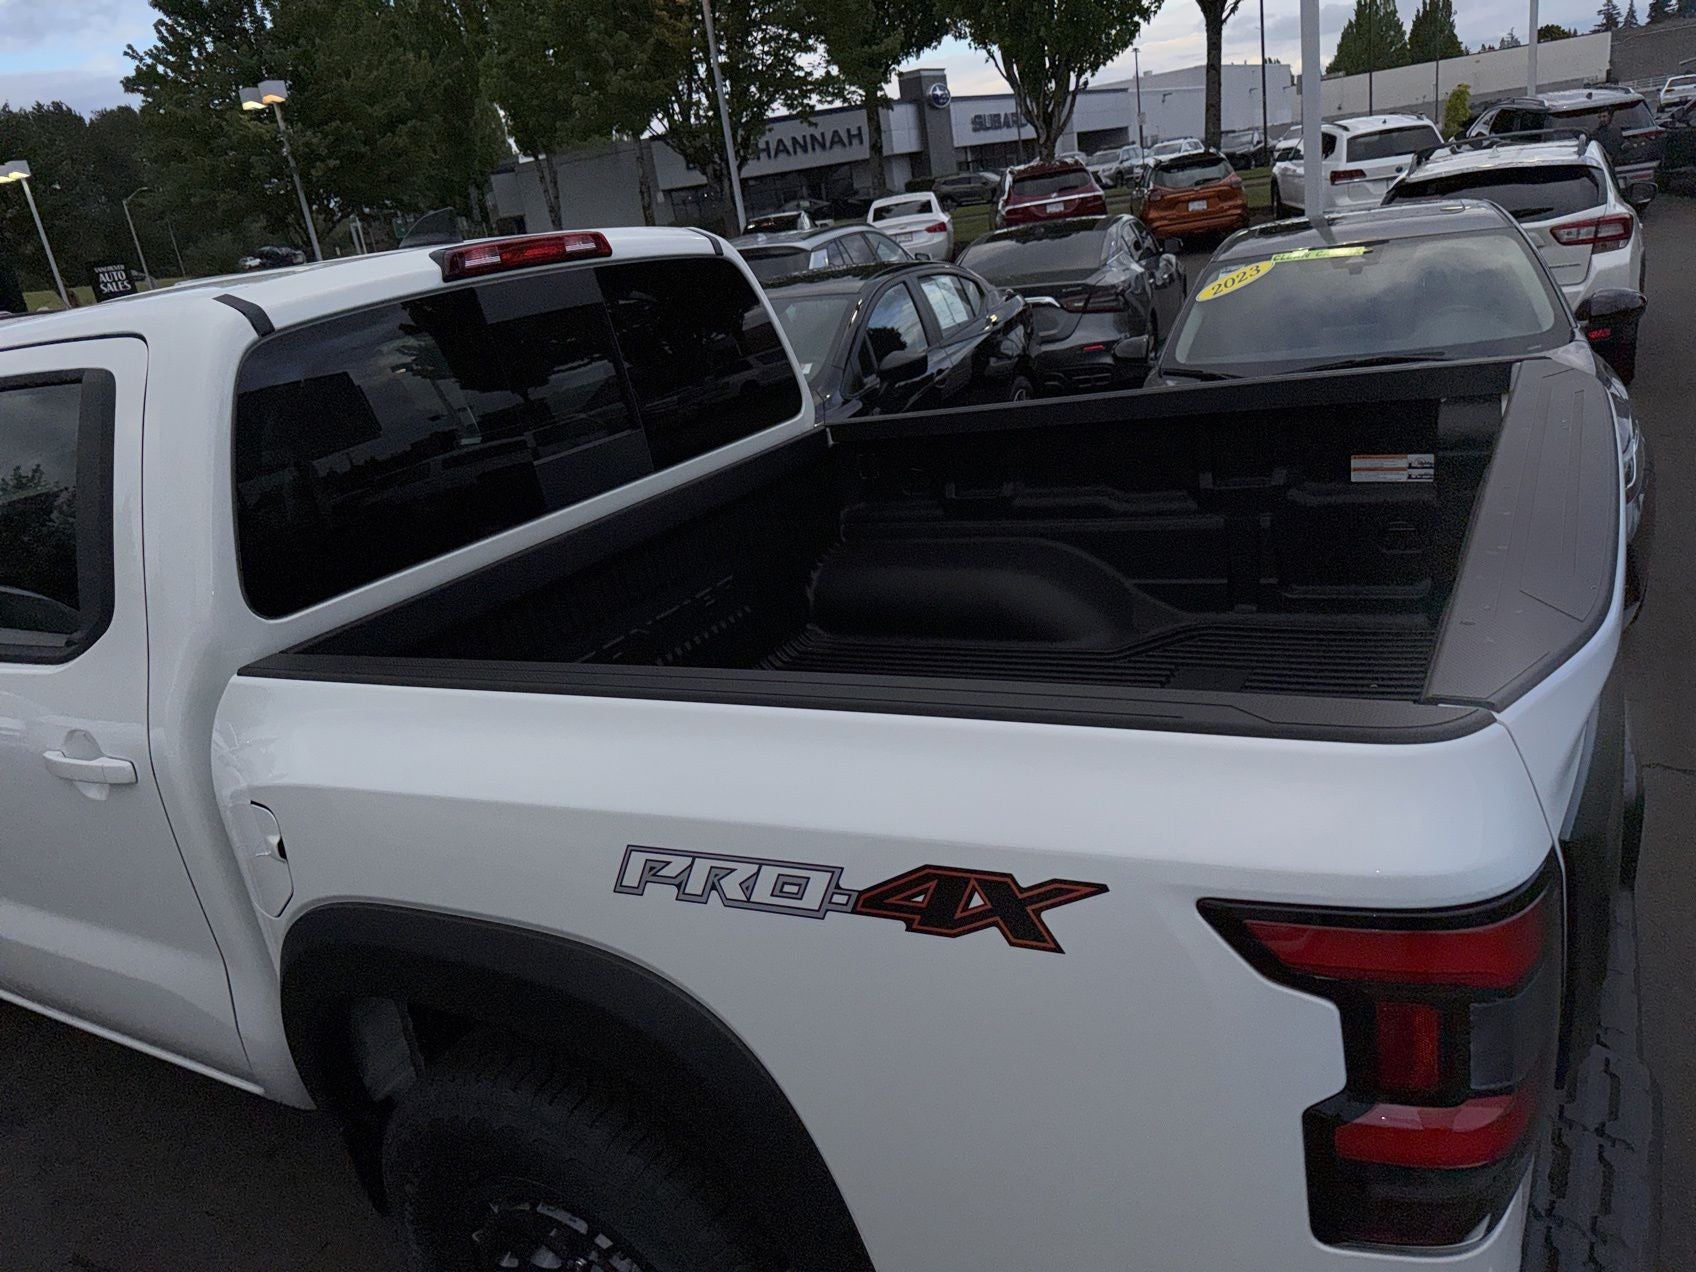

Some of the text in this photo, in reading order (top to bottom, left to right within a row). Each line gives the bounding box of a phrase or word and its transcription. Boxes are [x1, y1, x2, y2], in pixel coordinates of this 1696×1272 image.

[756, 126, 864, 160] HANNAH
[99, 270, 126, 283] AUTO
[100, 280, 132, 293] SALES
[1211, 265, 1261, 295] 2023
[613, 844, 1110, 954] PRO-4X
